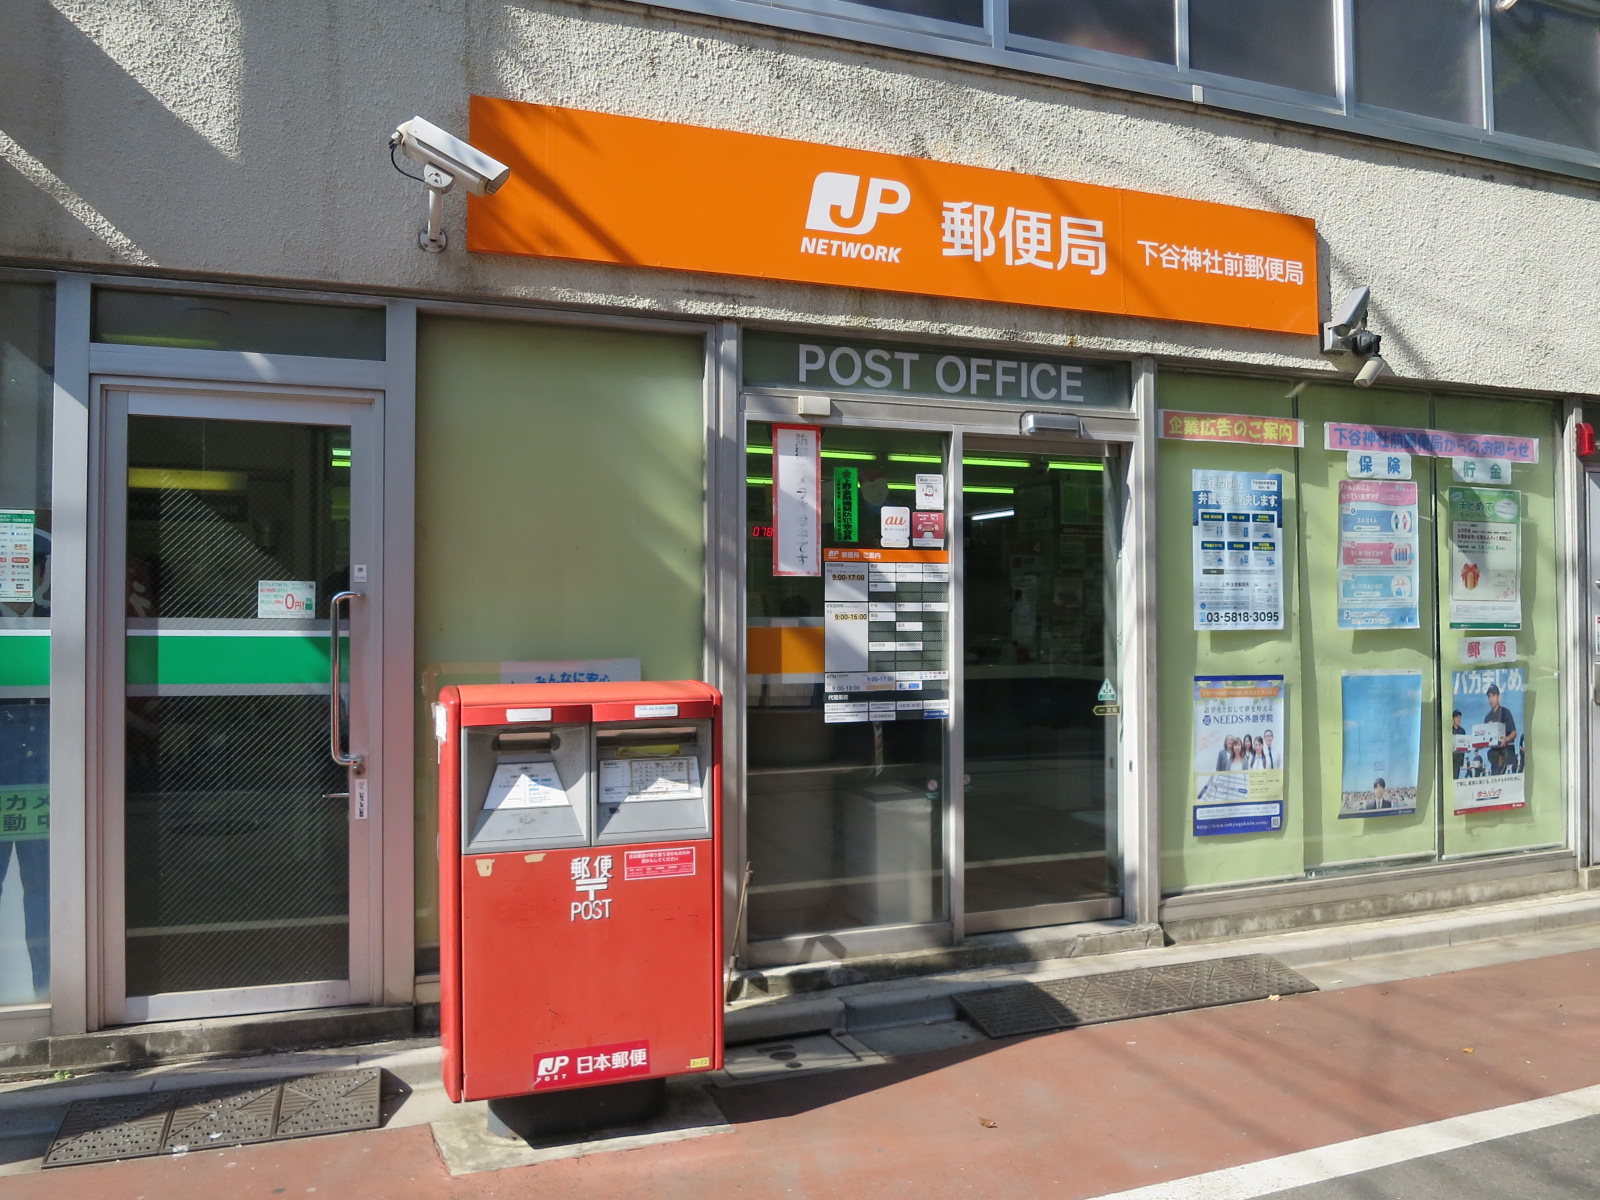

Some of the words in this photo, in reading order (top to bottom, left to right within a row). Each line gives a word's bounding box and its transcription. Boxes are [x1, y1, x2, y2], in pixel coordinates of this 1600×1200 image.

[941, 200, 1108, 276] 郵便局
[800, 236, 902, 264] NETWORK
[1136, 239, 1304, 286] 下谷神社前郵便局
[798, 344, 921, 390] POST
[935, 354, 1085, 402] OFFICE
[1168, 415, 1293, 442] 企業広告のご案内
[1334, 427, 1530, 458] 下谷神社前郵便局からのお知らせ
[1358, 455, 1401, 474] 保険
[1463, 461, 1502, 480] 貯金
[1458, 500, 1495, 512] まとめて
[885, 515, 906, 526] au
[834, 613, 868, 621] 9:00-16:00
[1206, 611, 1279, 623] 03-5818-3095
[1466, 640, 1507, 659] 郵便
[0, 794, 49, 811] カメ
[570, 855, 613, 879] 郵便
[570, 899, 613, 921] POST
[577, 1048, 647, 1075] 日本郵便
